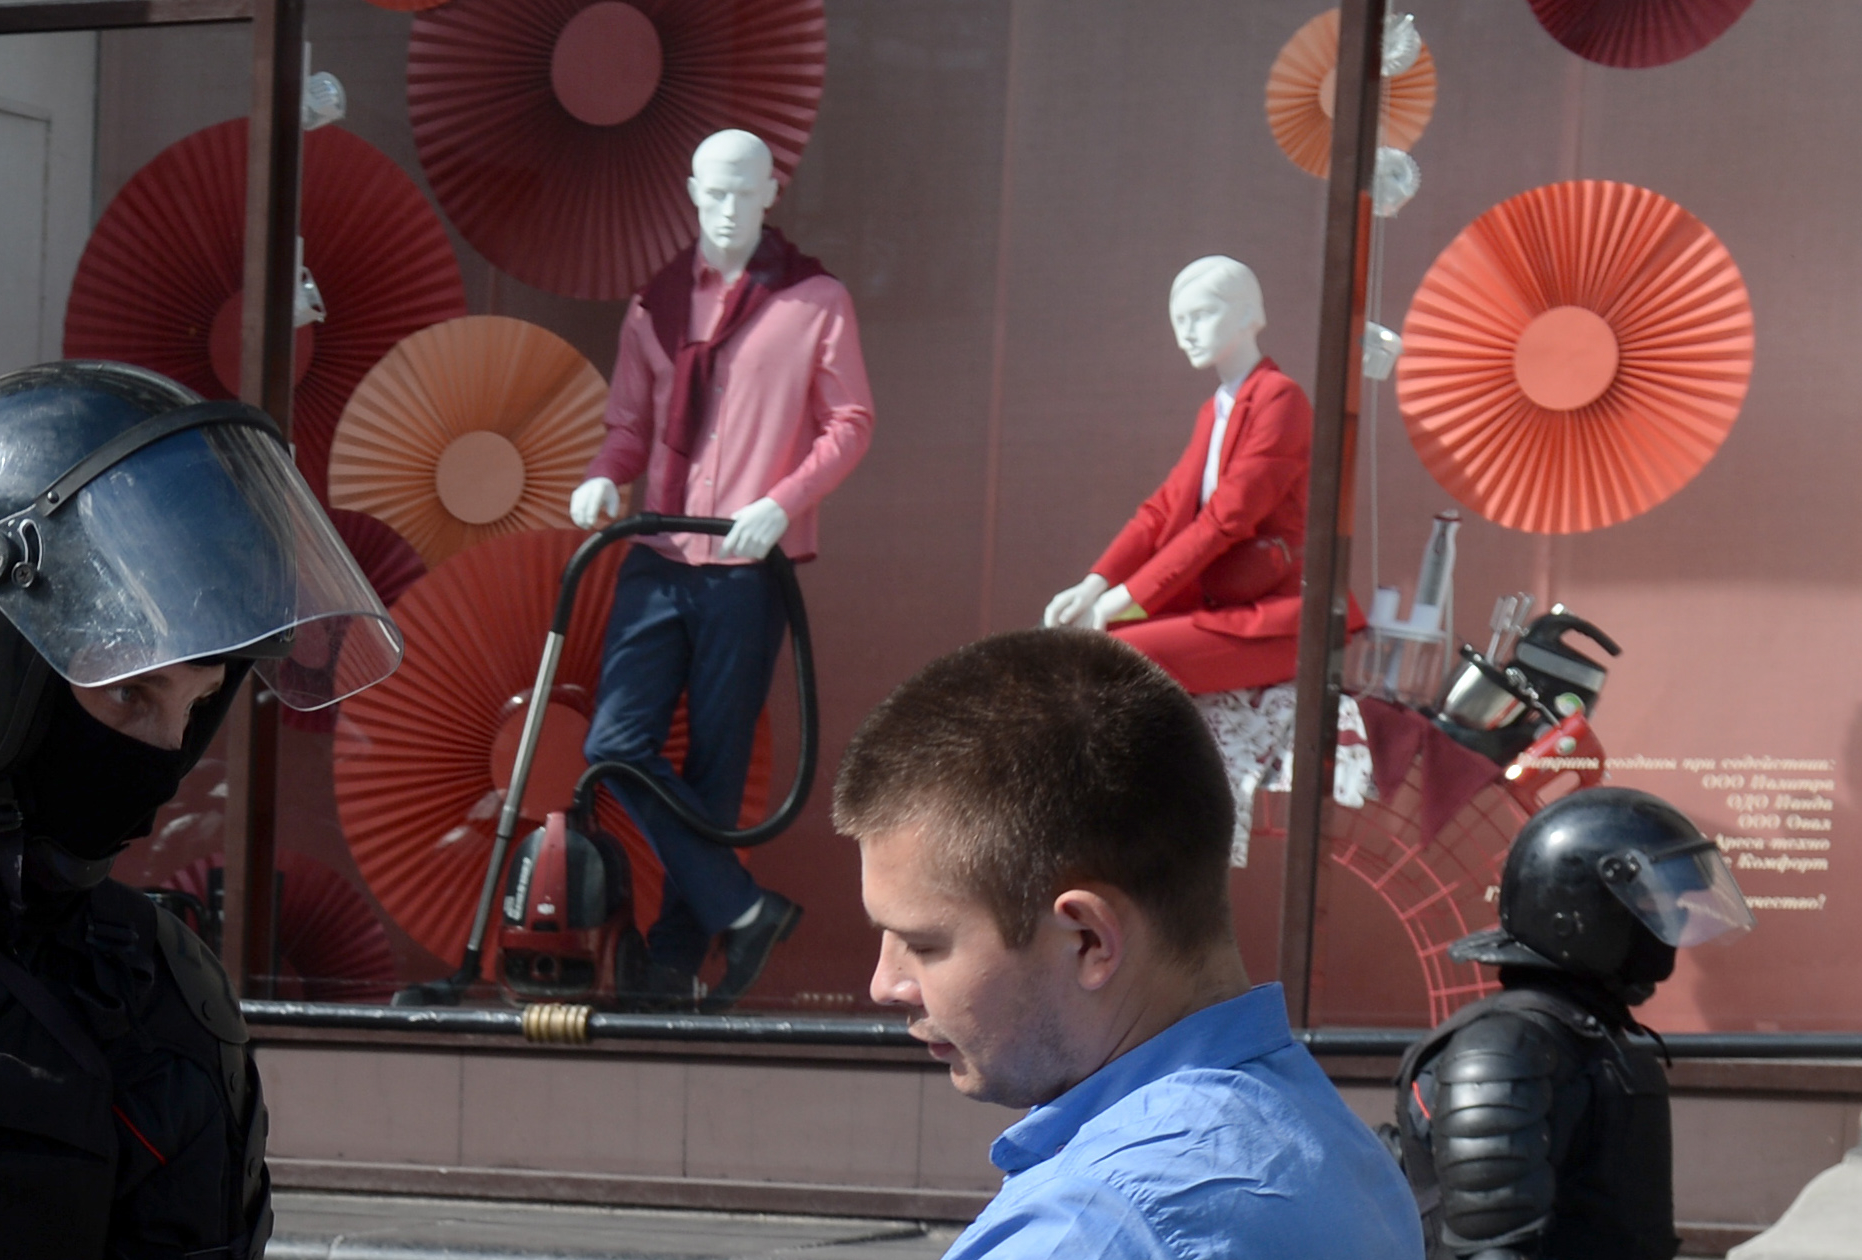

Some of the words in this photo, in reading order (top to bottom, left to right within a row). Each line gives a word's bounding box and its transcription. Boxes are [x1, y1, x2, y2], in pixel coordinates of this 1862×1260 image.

[1682, 757, 1716, 773] при
[1702, 773, 1745, 790] ООО
[1738, 813, 1781, 830] ООО
